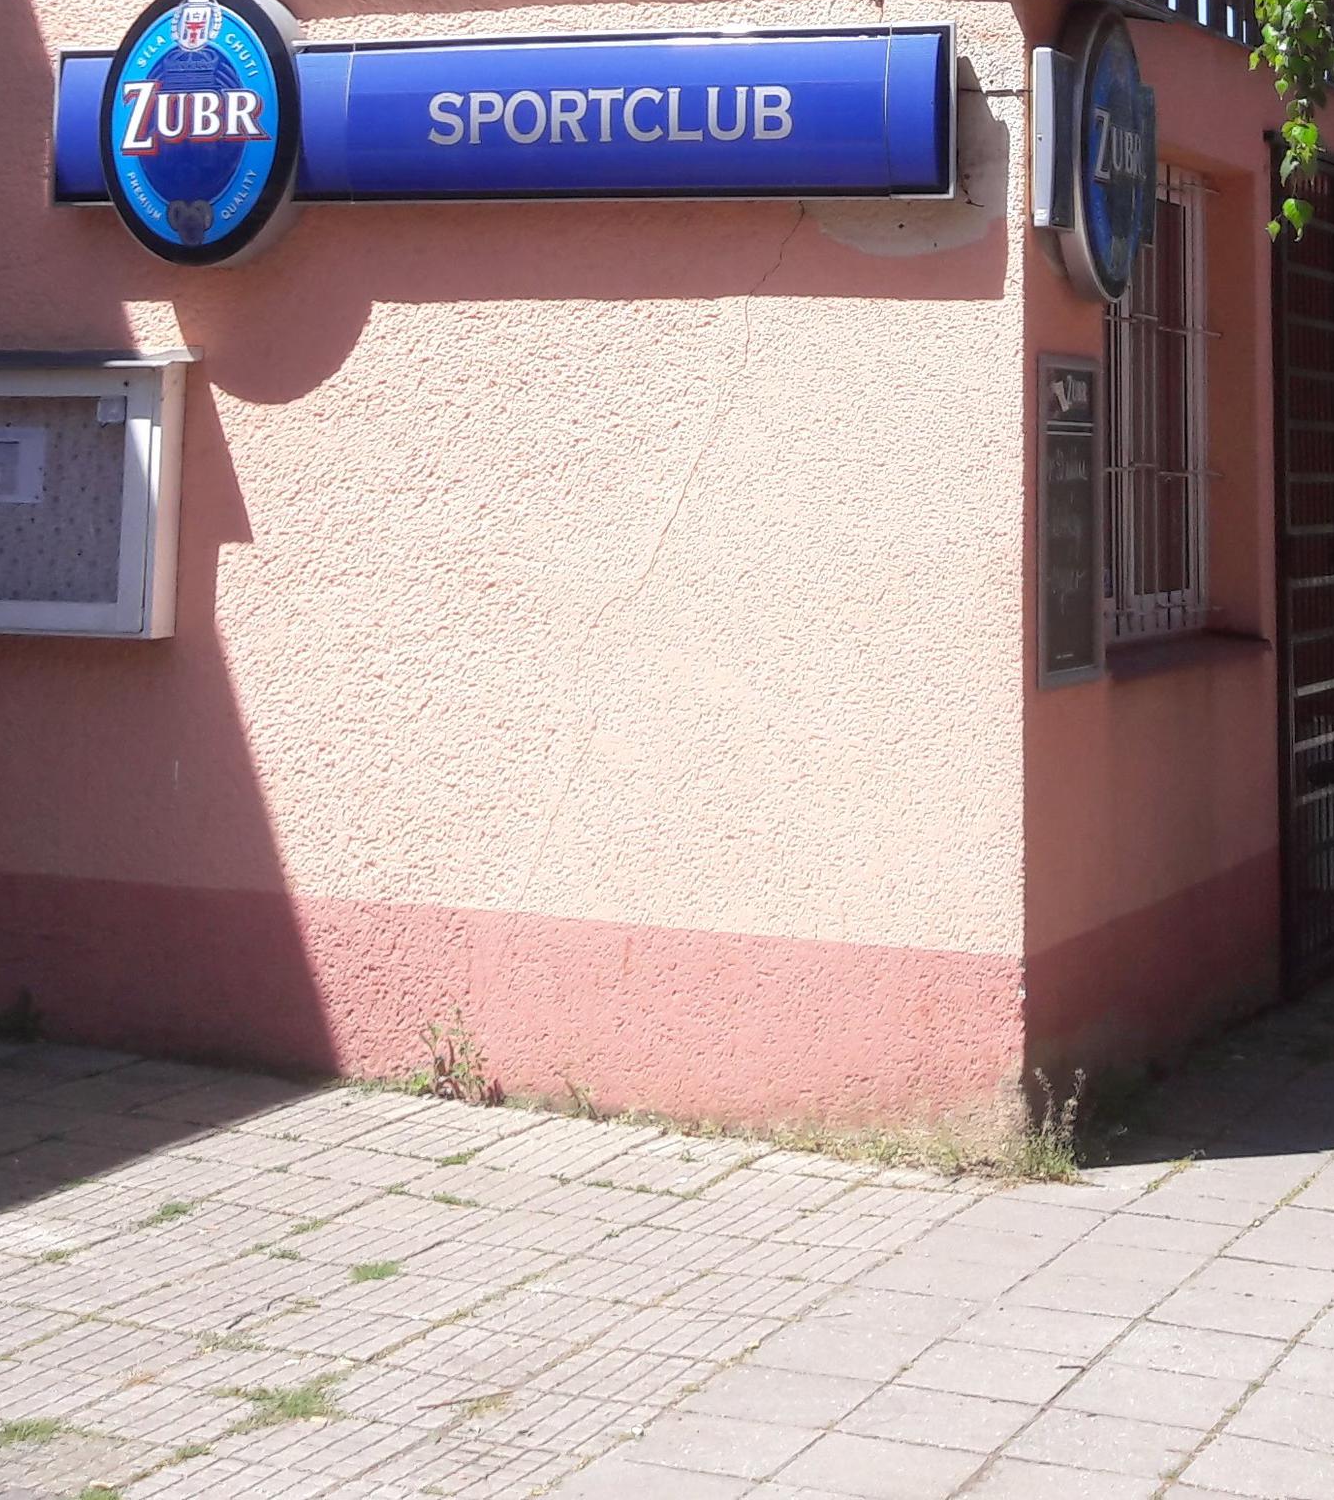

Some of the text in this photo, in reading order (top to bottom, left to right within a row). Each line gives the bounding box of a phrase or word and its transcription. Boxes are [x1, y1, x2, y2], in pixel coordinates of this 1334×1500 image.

[225, 33, 259, 77] CHUTI
[121, 80, 271, 155] ZUBR
[428, 86, 793, 146] SPORTCLUB
[1093, 108, 1147, 182] ZUBR
[127, 168, 258, 220] PREMIUM QUALITY
